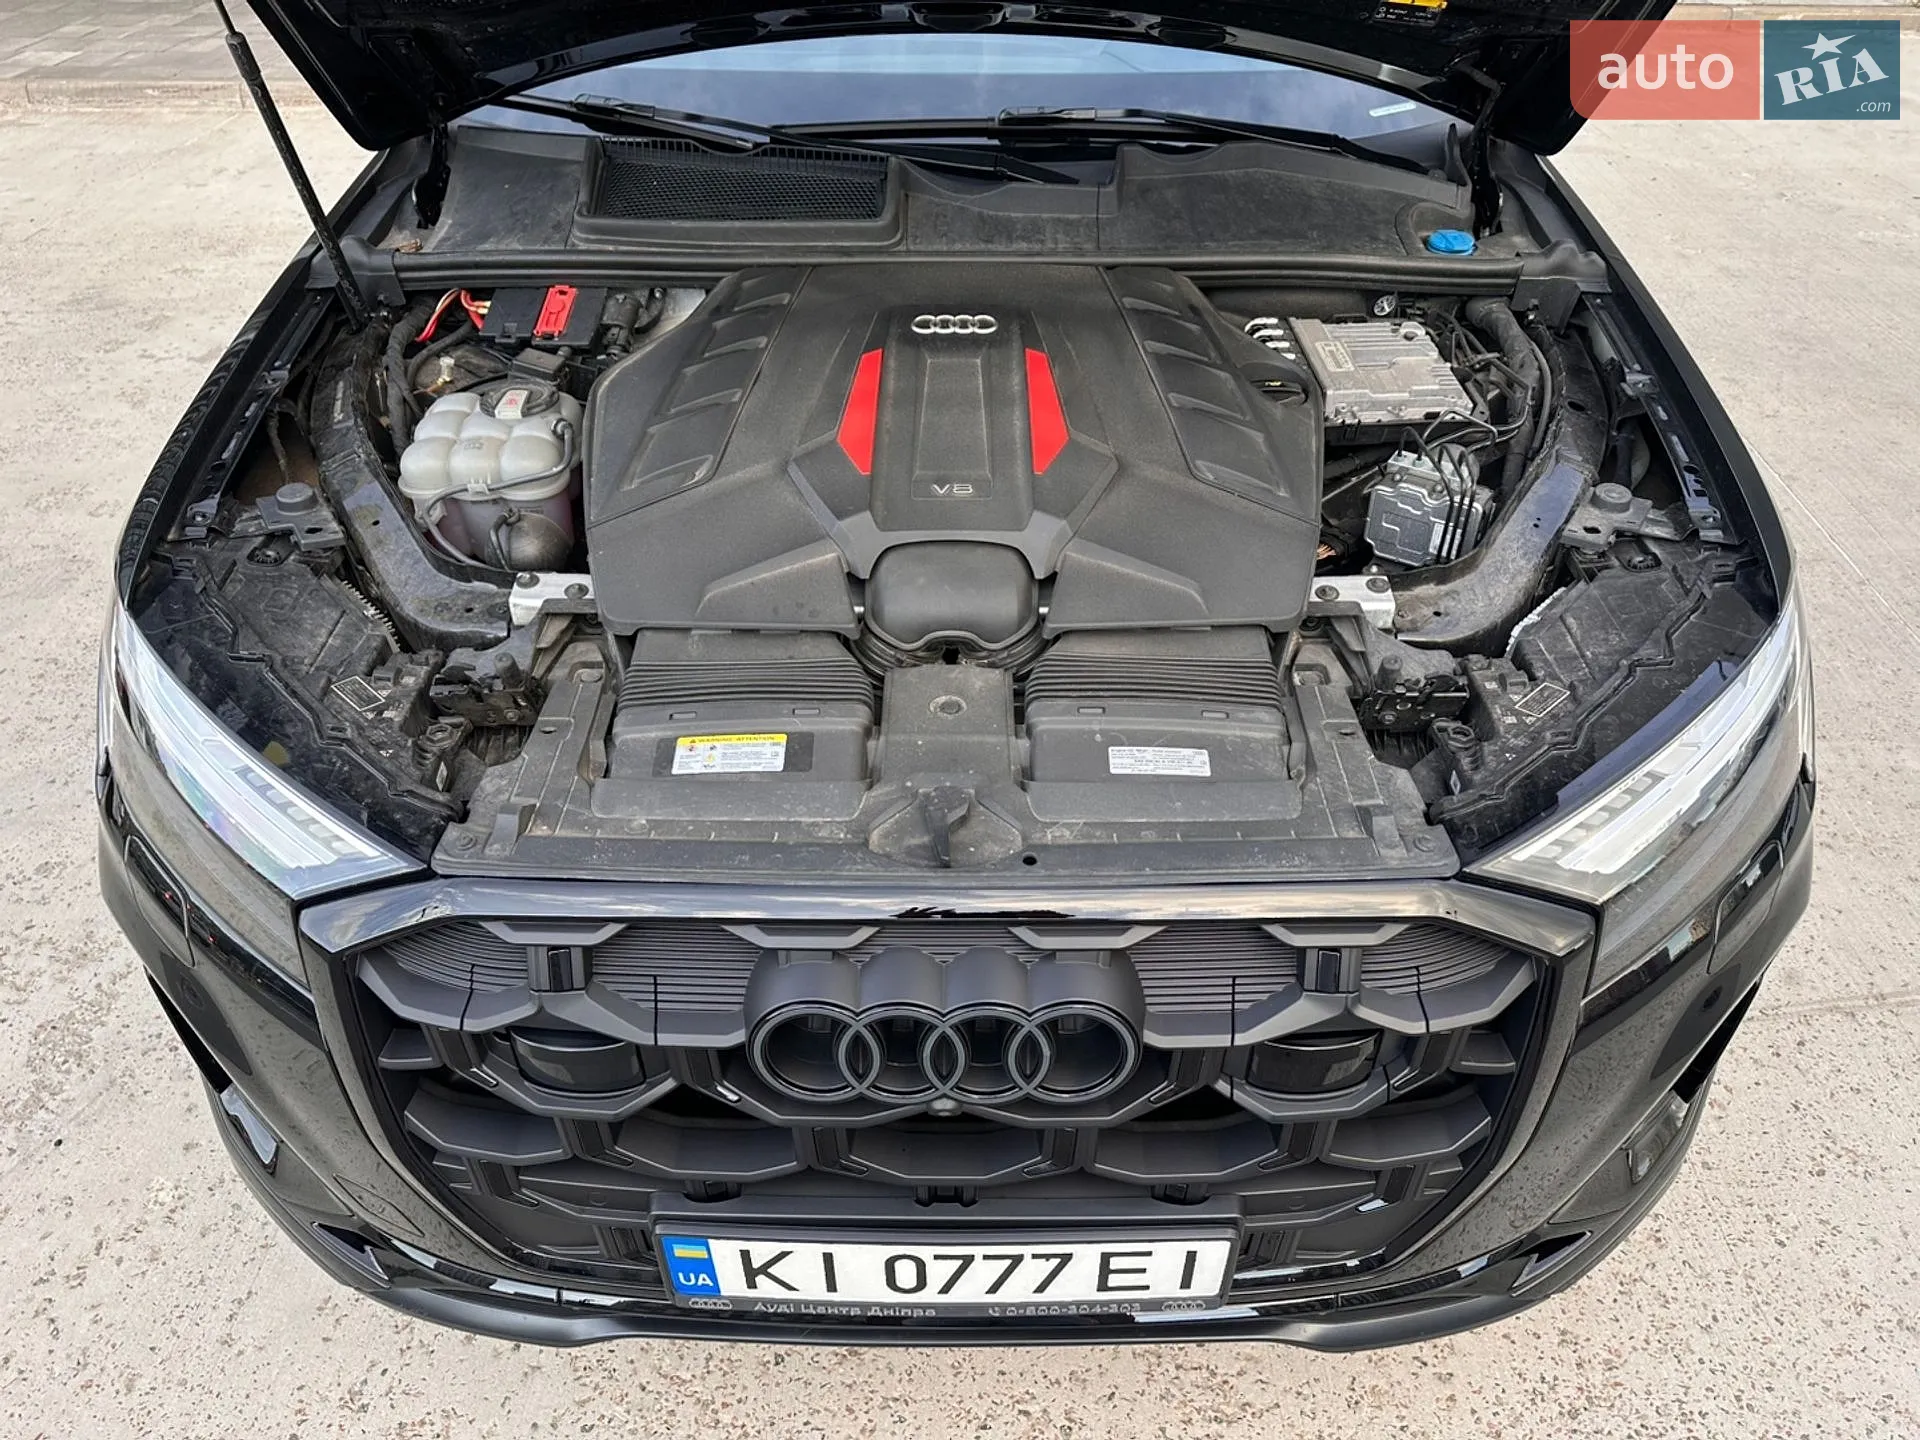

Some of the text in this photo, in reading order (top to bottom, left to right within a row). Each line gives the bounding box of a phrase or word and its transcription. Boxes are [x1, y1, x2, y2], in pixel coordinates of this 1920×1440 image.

[932, 483, 974, 494] V8
[678, 1272, 713, 1287] UA
[739, 1249, 1198, 1295] KI 0777 EI
